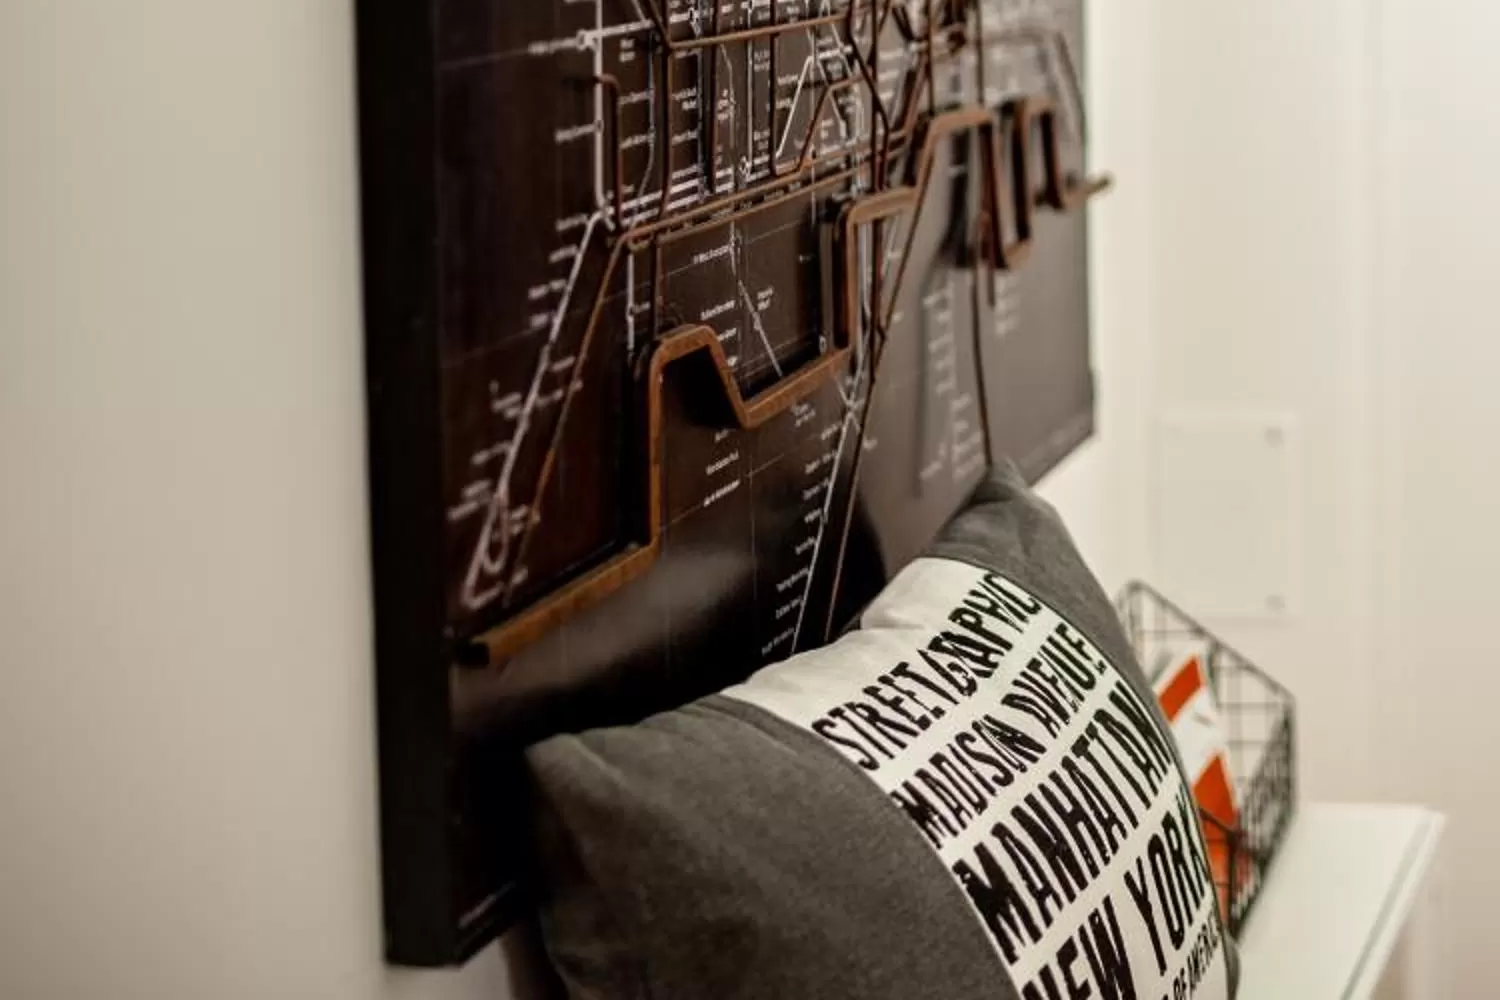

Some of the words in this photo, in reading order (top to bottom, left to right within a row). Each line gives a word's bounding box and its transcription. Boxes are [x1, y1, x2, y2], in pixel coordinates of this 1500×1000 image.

[812, 661, 959, 771] STREET
[890, 714, 1047, 849] MADISON
[952, 680, 1172, 965] MANHATTAN
[1022, 894, 1137, 1000] EW
[1123, 783, 1206, 976] YORK
